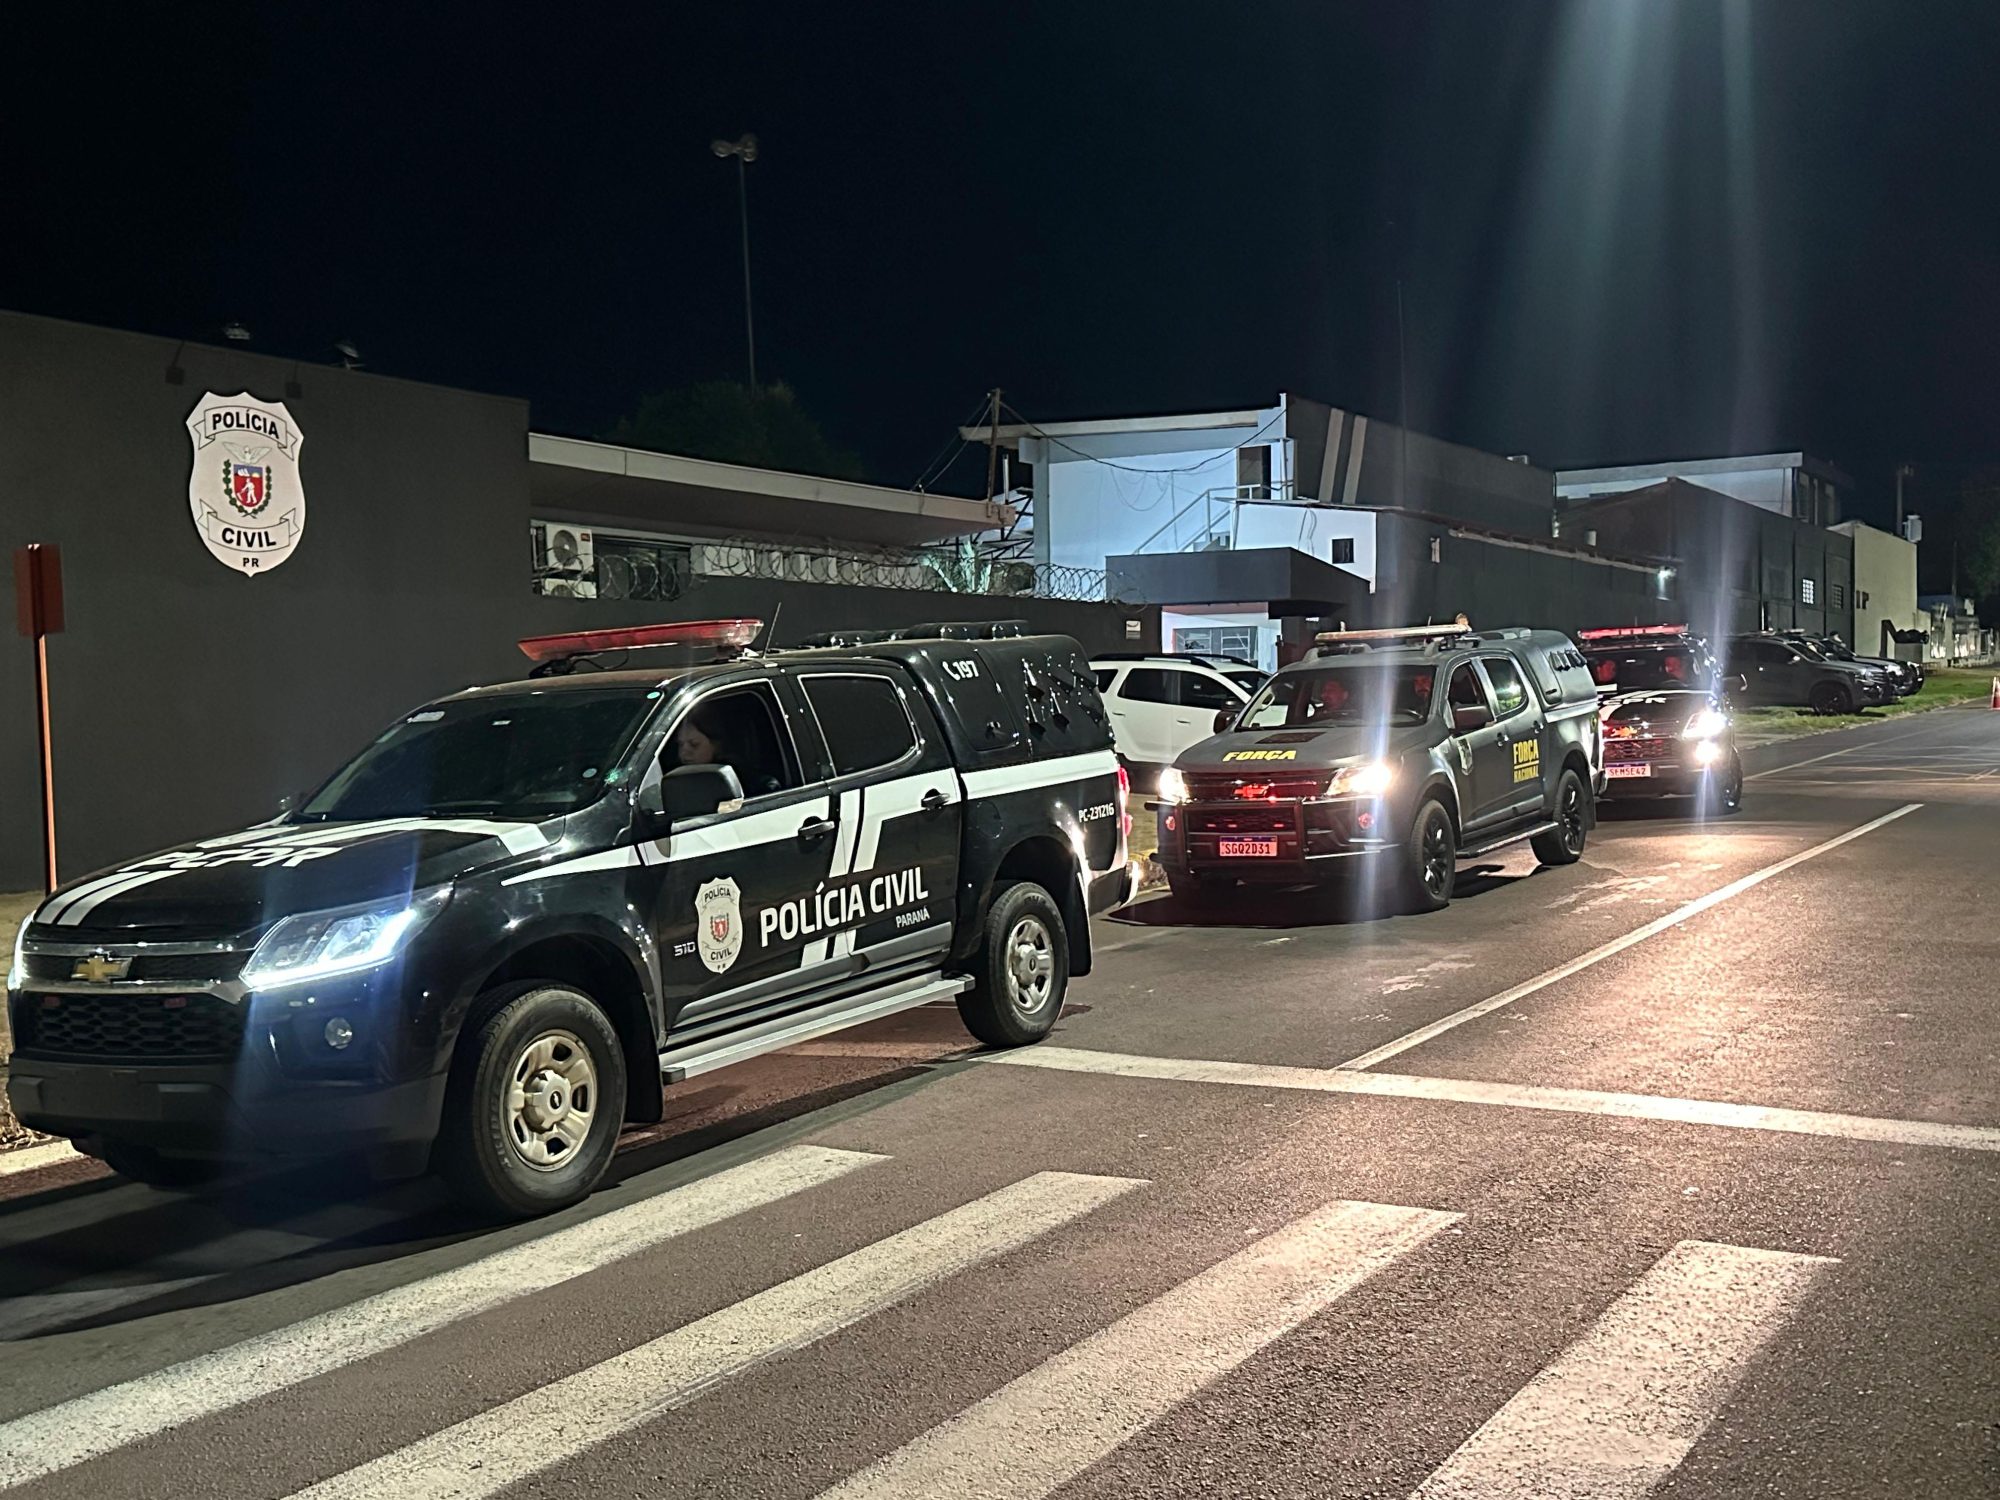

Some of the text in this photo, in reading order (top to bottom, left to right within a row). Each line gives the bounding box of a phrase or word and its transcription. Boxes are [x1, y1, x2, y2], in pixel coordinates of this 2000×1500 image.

[212, 409, 279, 439] POLÍCIA
[222, 528, 277, 548] CIVIL
[243, 558, 259, 567] PR
[953, 660, 979, 678] 197
[1223, 750, 1297, 761] FORÇA
[1513, 739, 1539, 764] FORÇA
[1078, 802, 1115, 822] PC-231216
[1225, 843, 1271, 855] SGQ2D31
[705, 885, 731, 902] POLÍCIA
[760, 867, 929, 947] POLÍCIA CIVIL
[896, 905, 930, 928] PARANÁ
[711, 947, 732, 961] CIVIL
